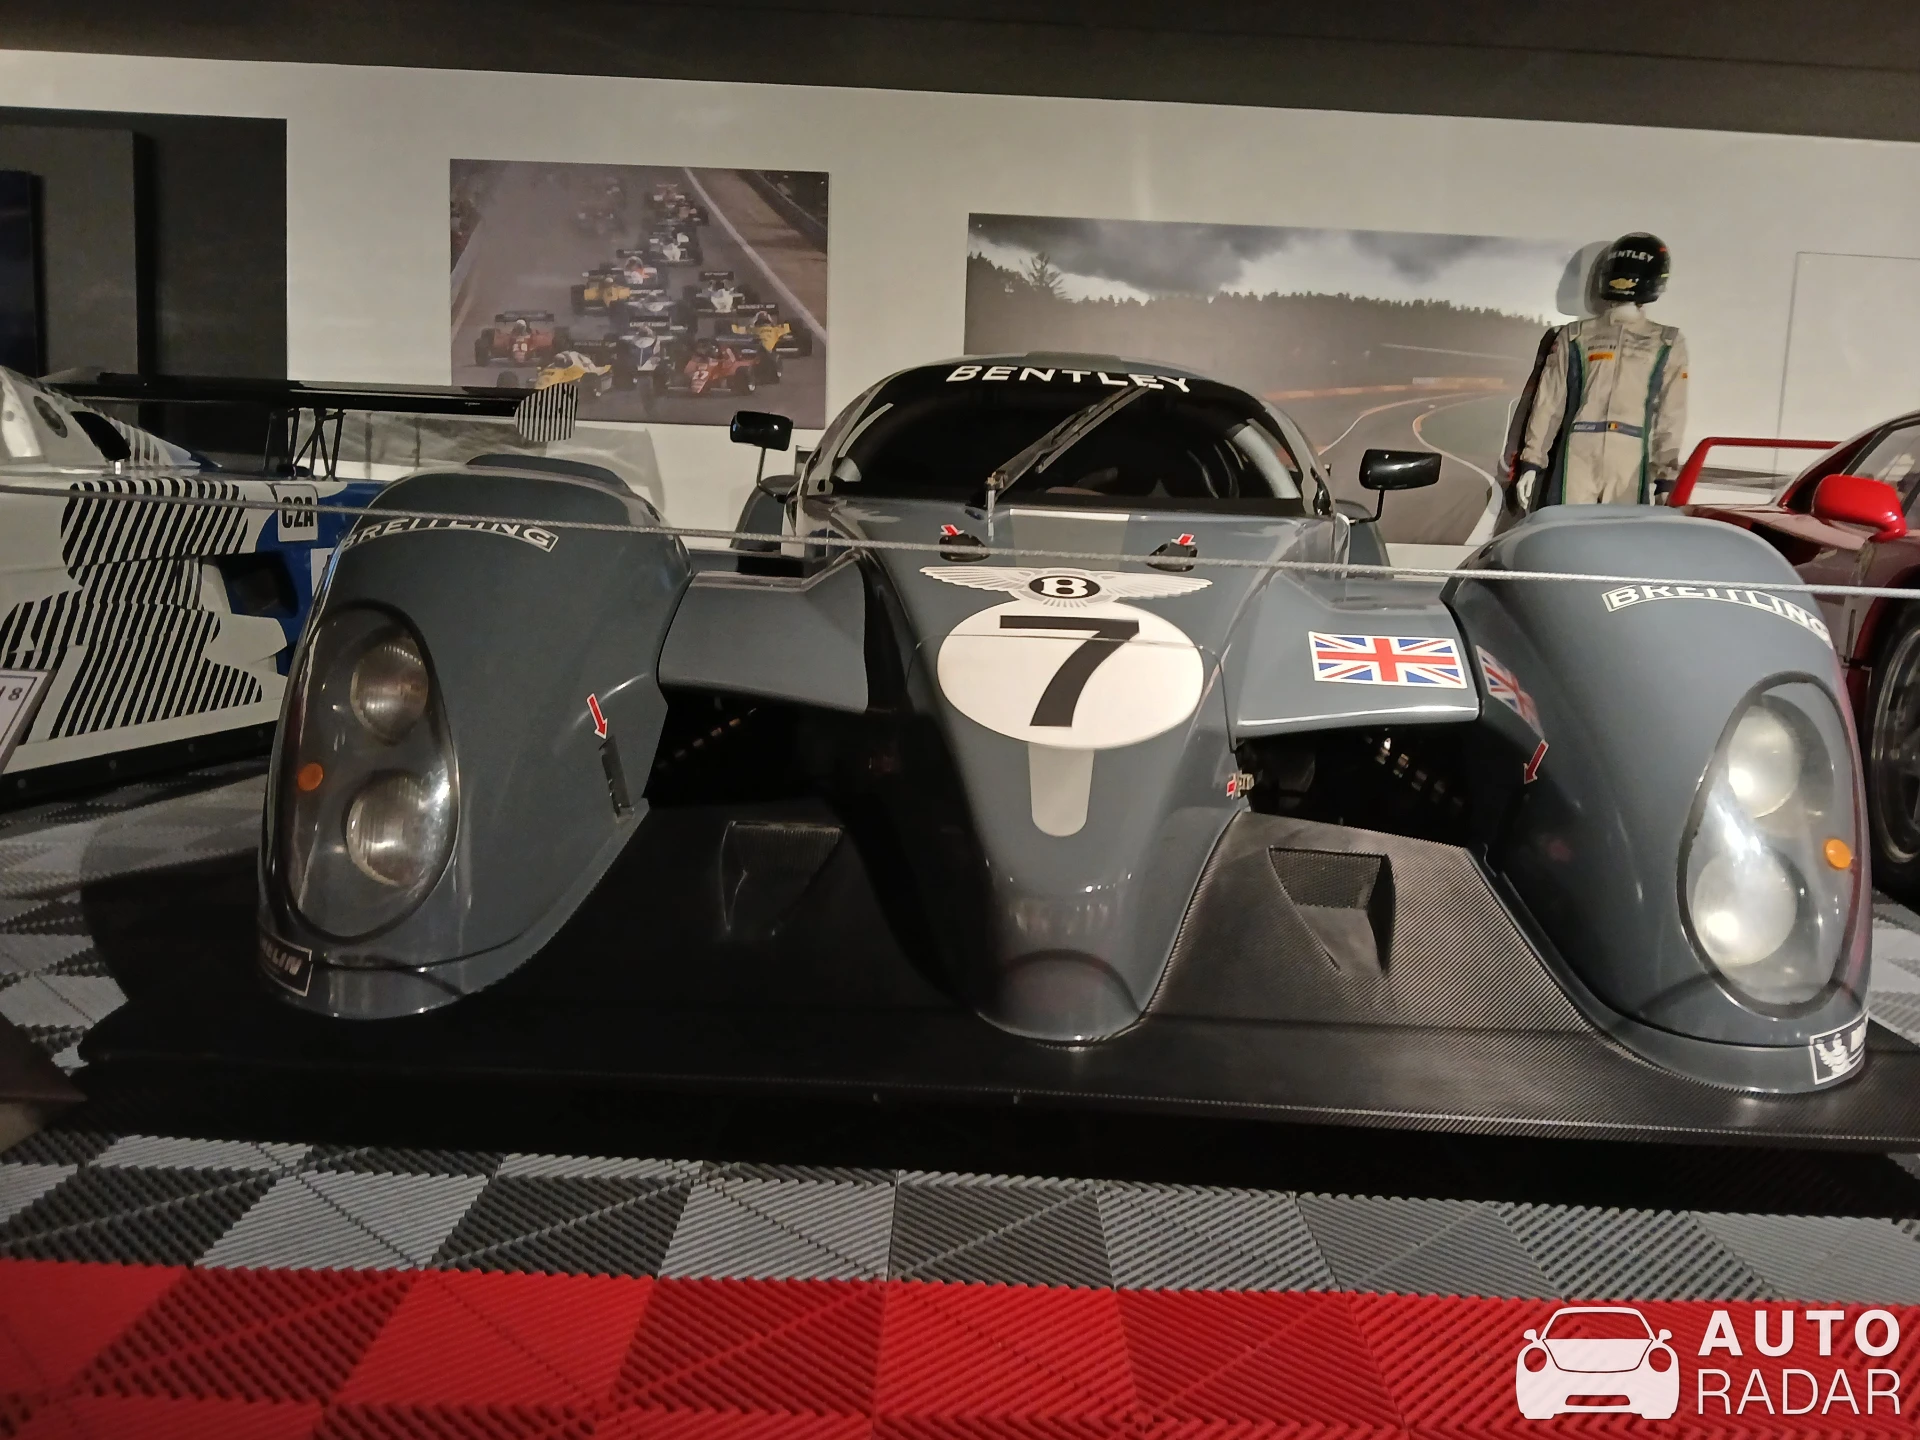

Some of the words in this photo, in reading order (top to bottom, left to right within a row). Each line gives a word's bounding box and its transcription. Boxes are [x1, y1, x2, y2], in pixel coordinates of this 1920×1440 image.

[946, 365, 1190, 393] BENTLEY
[1041, 576, 1088, 597] B
[1000, 614, 1140, 728] 7
